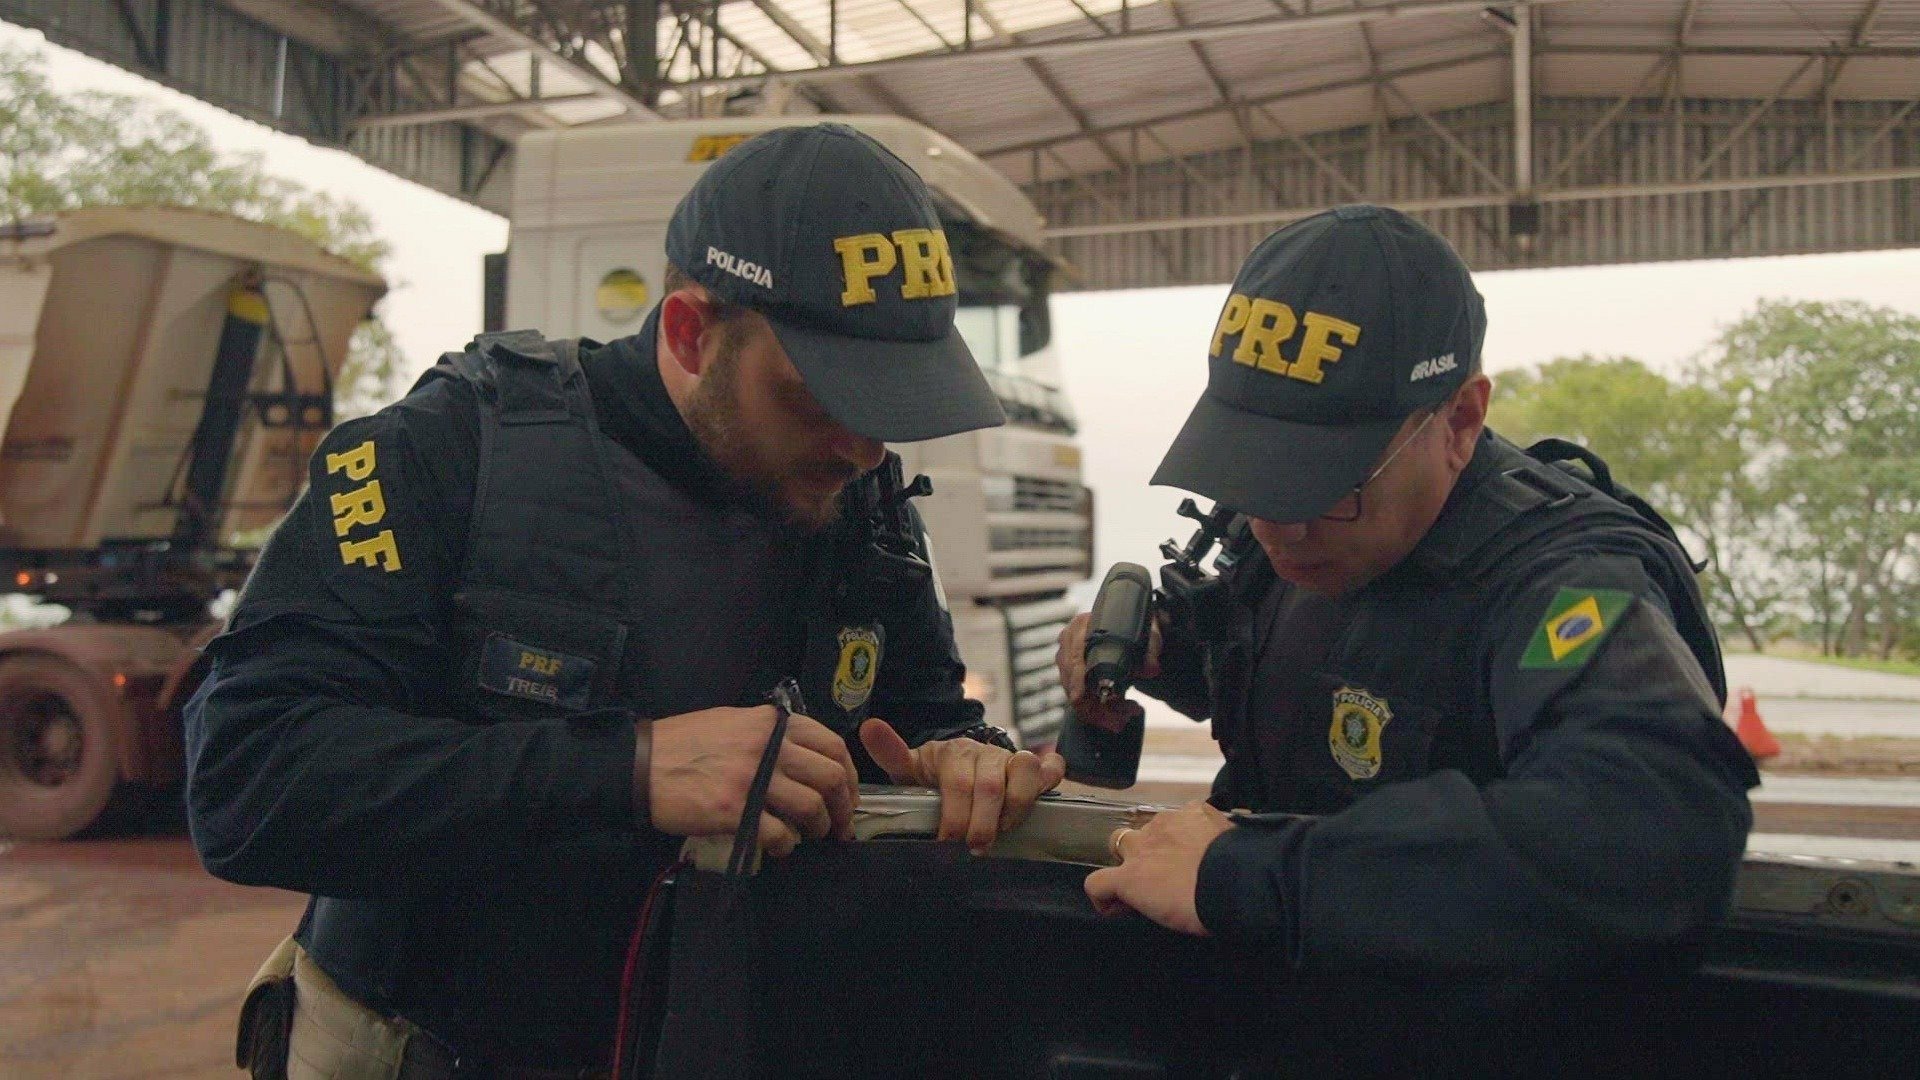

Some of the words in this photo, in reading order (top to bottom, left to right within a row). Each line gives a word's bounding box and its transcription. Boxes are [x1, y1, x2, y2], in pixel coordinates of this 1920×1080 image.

[706, 246, 773, 289] POLICIA
[1209, 293, 1361, 384] PRF
[1410, 352, 1458, 382] BRASIL
[326, 441, 402, 572] PRF
[518, 652, 562, 675] PRF
[1340, 693, 1384, 720] POLICIA
